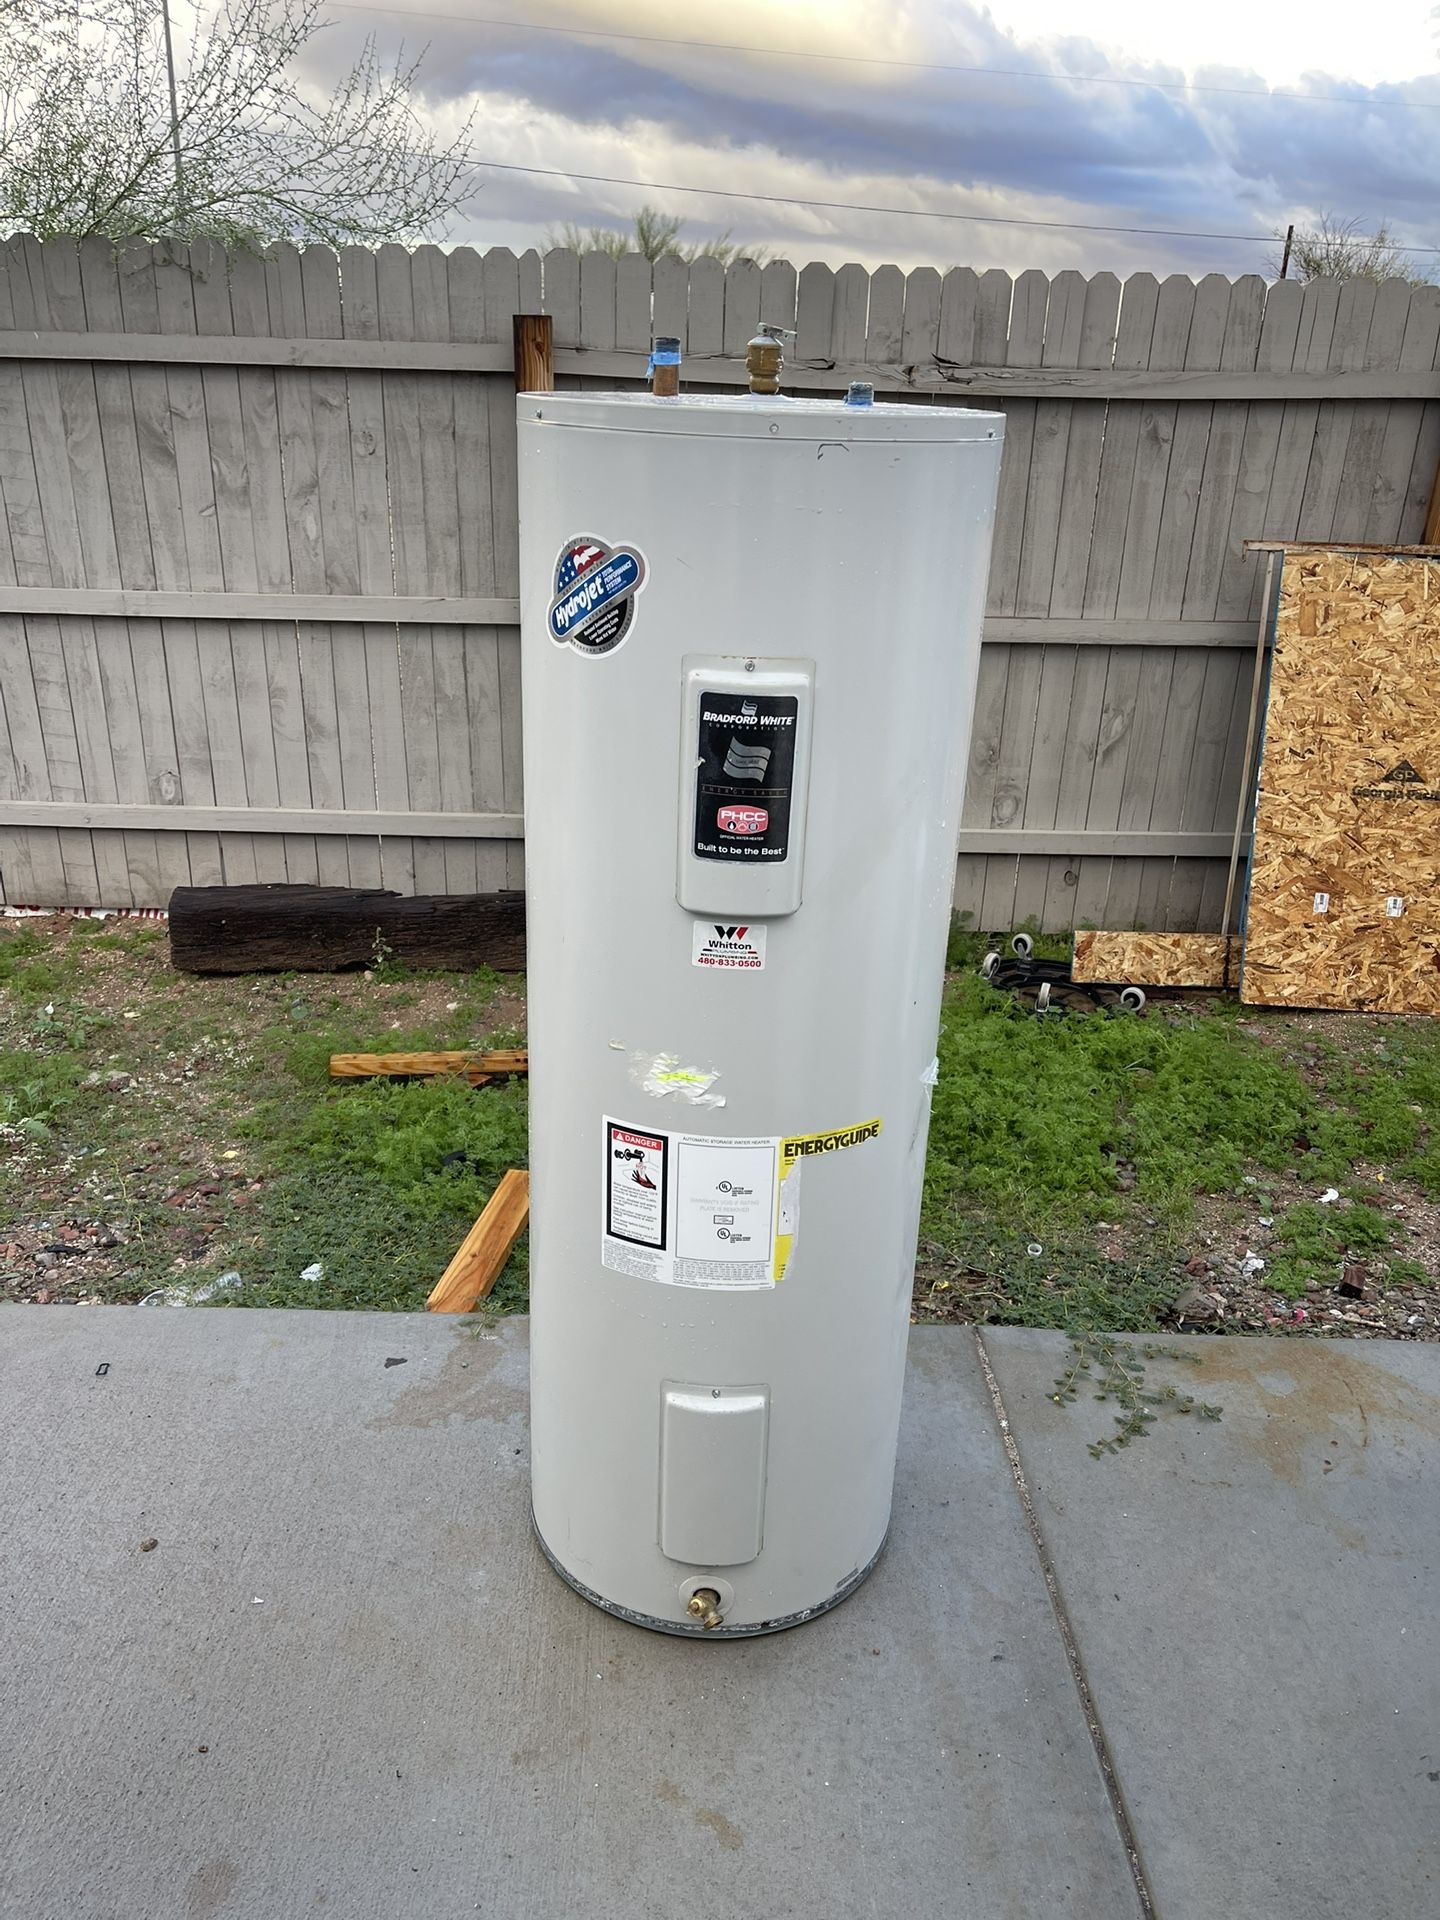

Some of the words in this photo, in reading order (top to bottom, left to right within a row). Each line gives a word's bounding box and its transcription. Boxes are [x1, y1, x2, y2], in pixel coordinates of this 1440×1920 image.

[555, 574, 605, 628] Hydrojet
[703, 711, 758, 725] BRADFORD
[760, 715, 793, 726] WHITE
[1392, 769, 1415, 780] GP
[720, 810, 766, 822] PHCC
[697, 842, 717, 852] Built
[730, 846, 742, 854] be
[744, 847, 760, 855] the
[761, 847, 782, 855] Best
[708, 940, 752, 950] Whitton
[624, 1134, 658, 1149] DANGER
[682, 1136, 710, 1144] AUTOMATIC
[784, 1124, 880, 1157] ENERGYGUIDE
